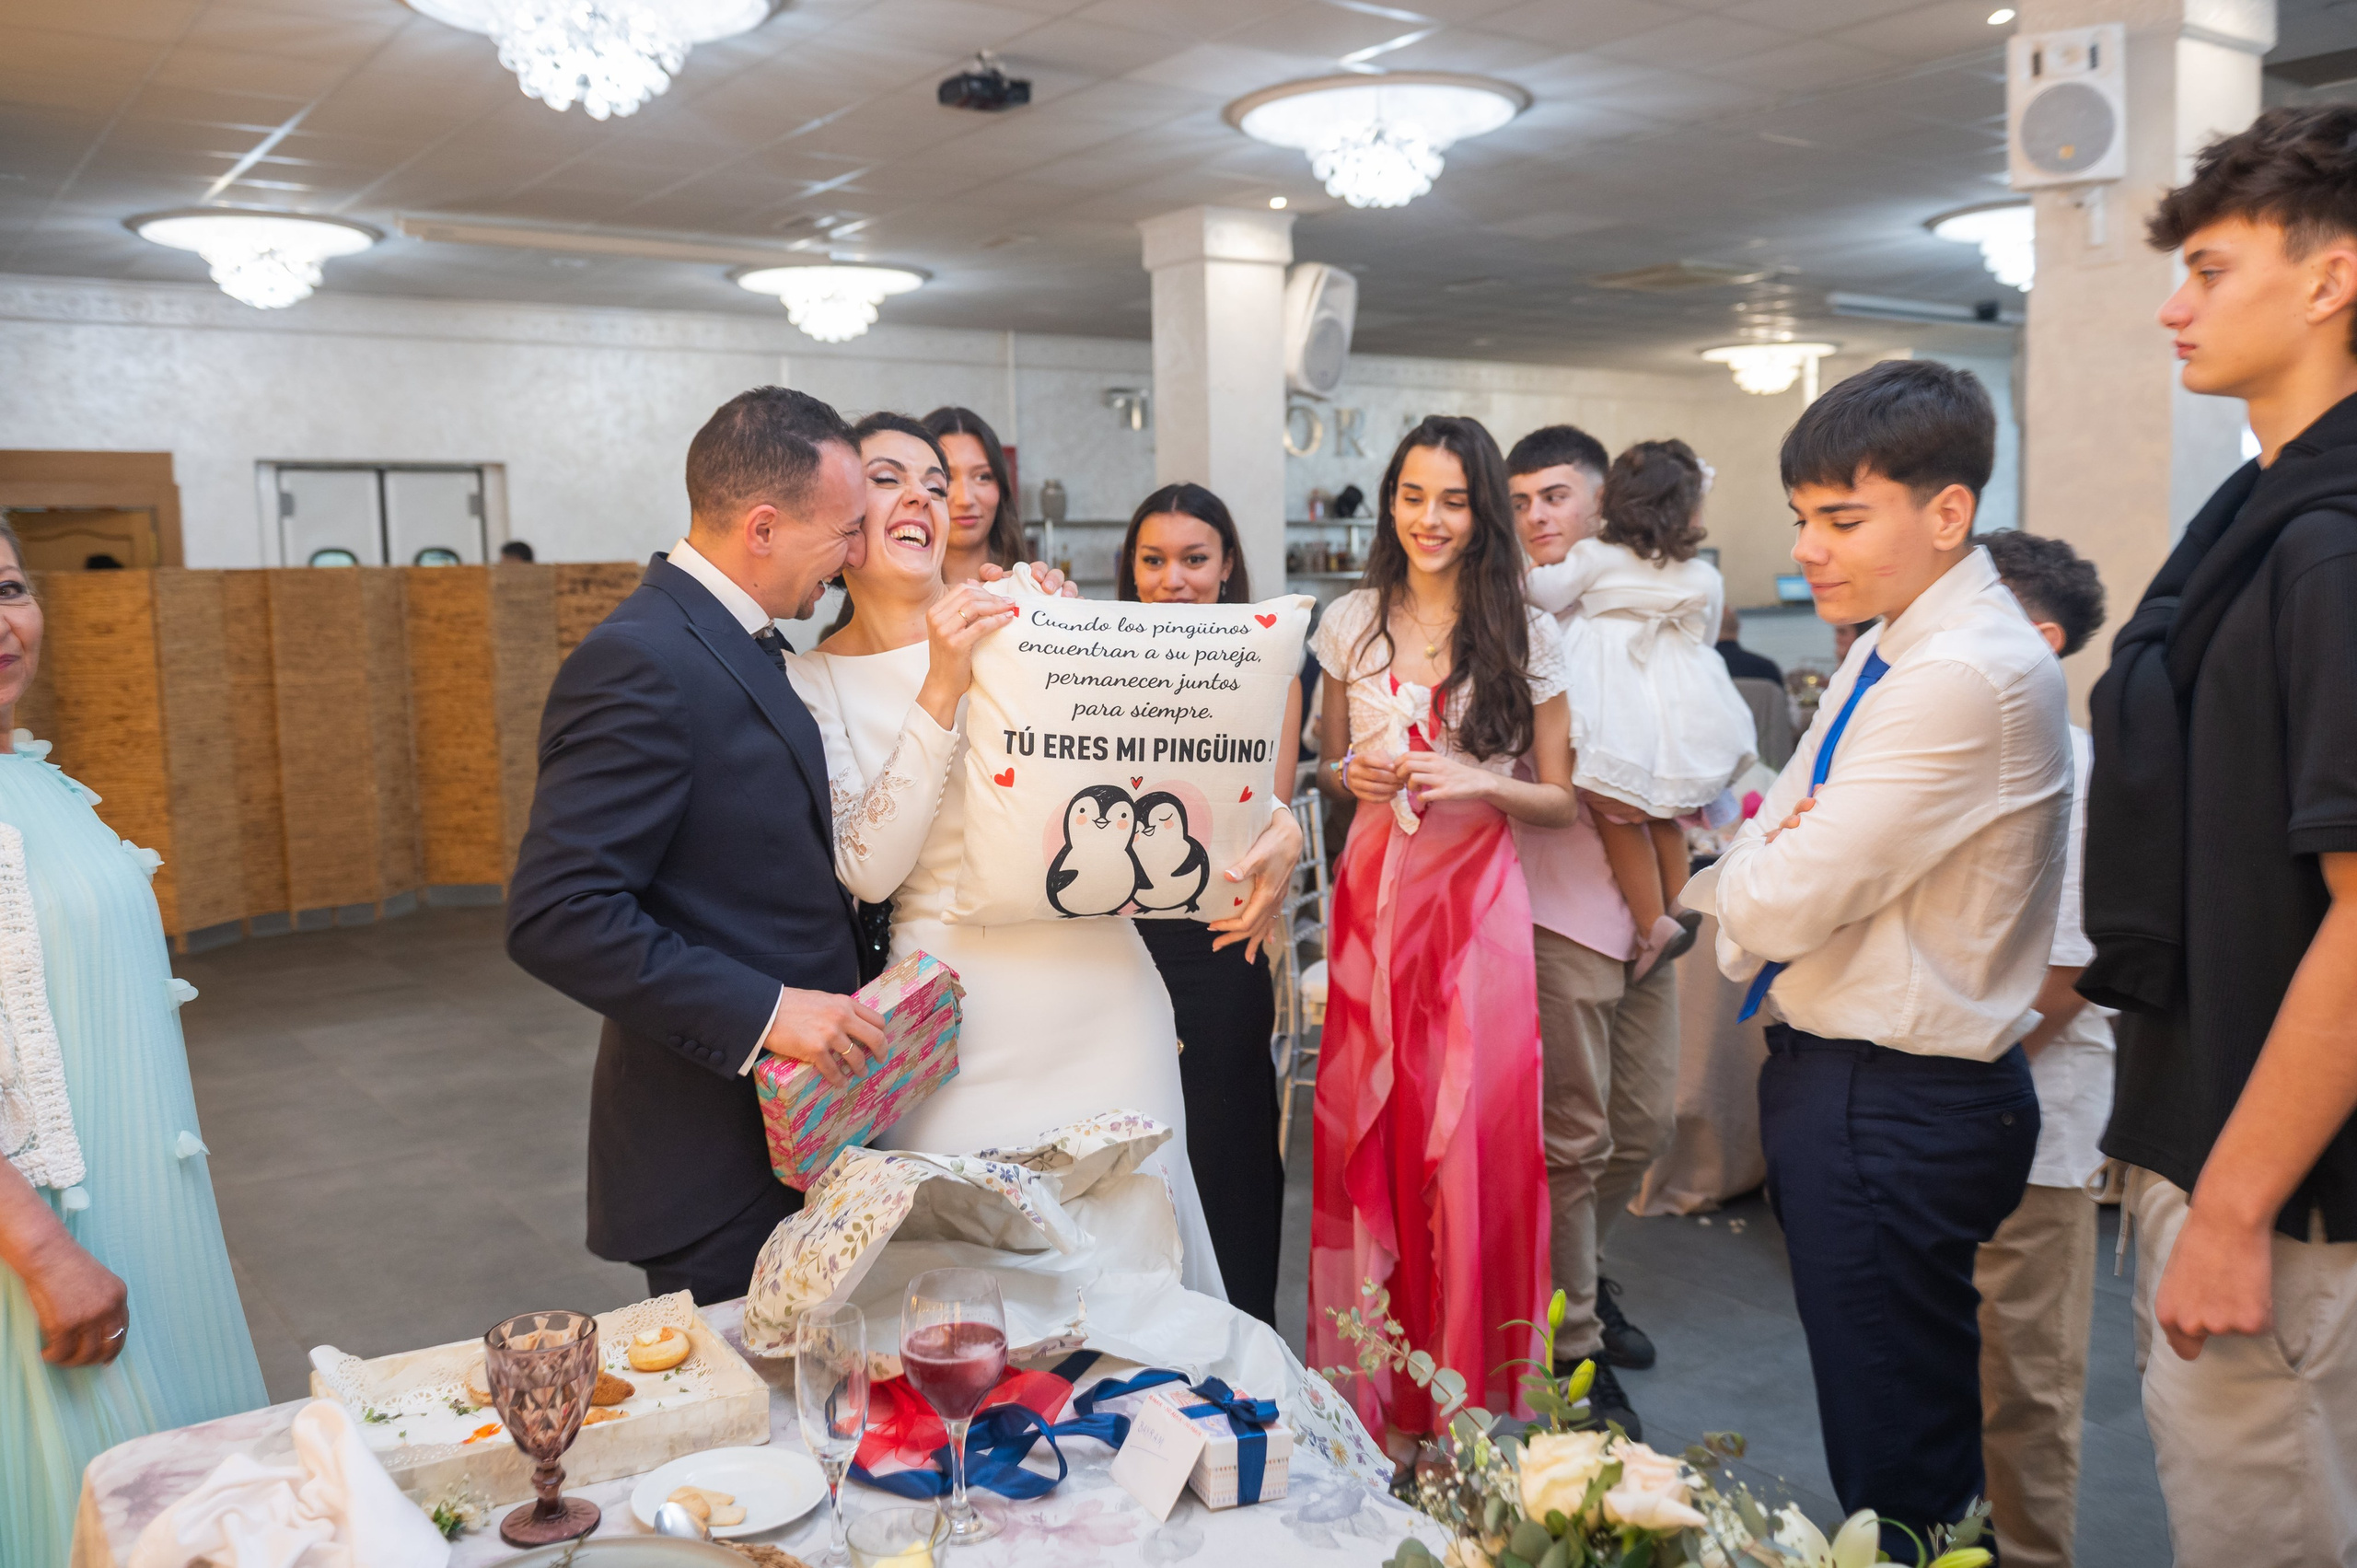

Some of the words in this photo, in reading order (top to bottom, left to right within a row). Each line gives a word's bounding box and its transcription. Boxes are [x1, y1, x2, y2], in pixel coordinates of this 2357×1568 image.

[1030, 610, 1111, 632] Cuando
[1117, 616, 1148, 633] los
[1152, 621, 1252, 639] pingüinos
[1017, 640, 1140, 659] encuentran
[1144, 648, 1161, 660] a
[1165, 648, 1190, 661] su
[1193, 649, 1261, 668] pareja,
[1044, 671, 1175, 691] permanecen
[1173, 672, 1241, 696] juntos
[1071, 703, 1126, 722] para
[1130, 701, 1213, 726] siempre.
[1003, 726, 1035, 757] TÚ
[1043, 733, 1109, 763] ERES
[1116, 736, 1146, 763] MI
